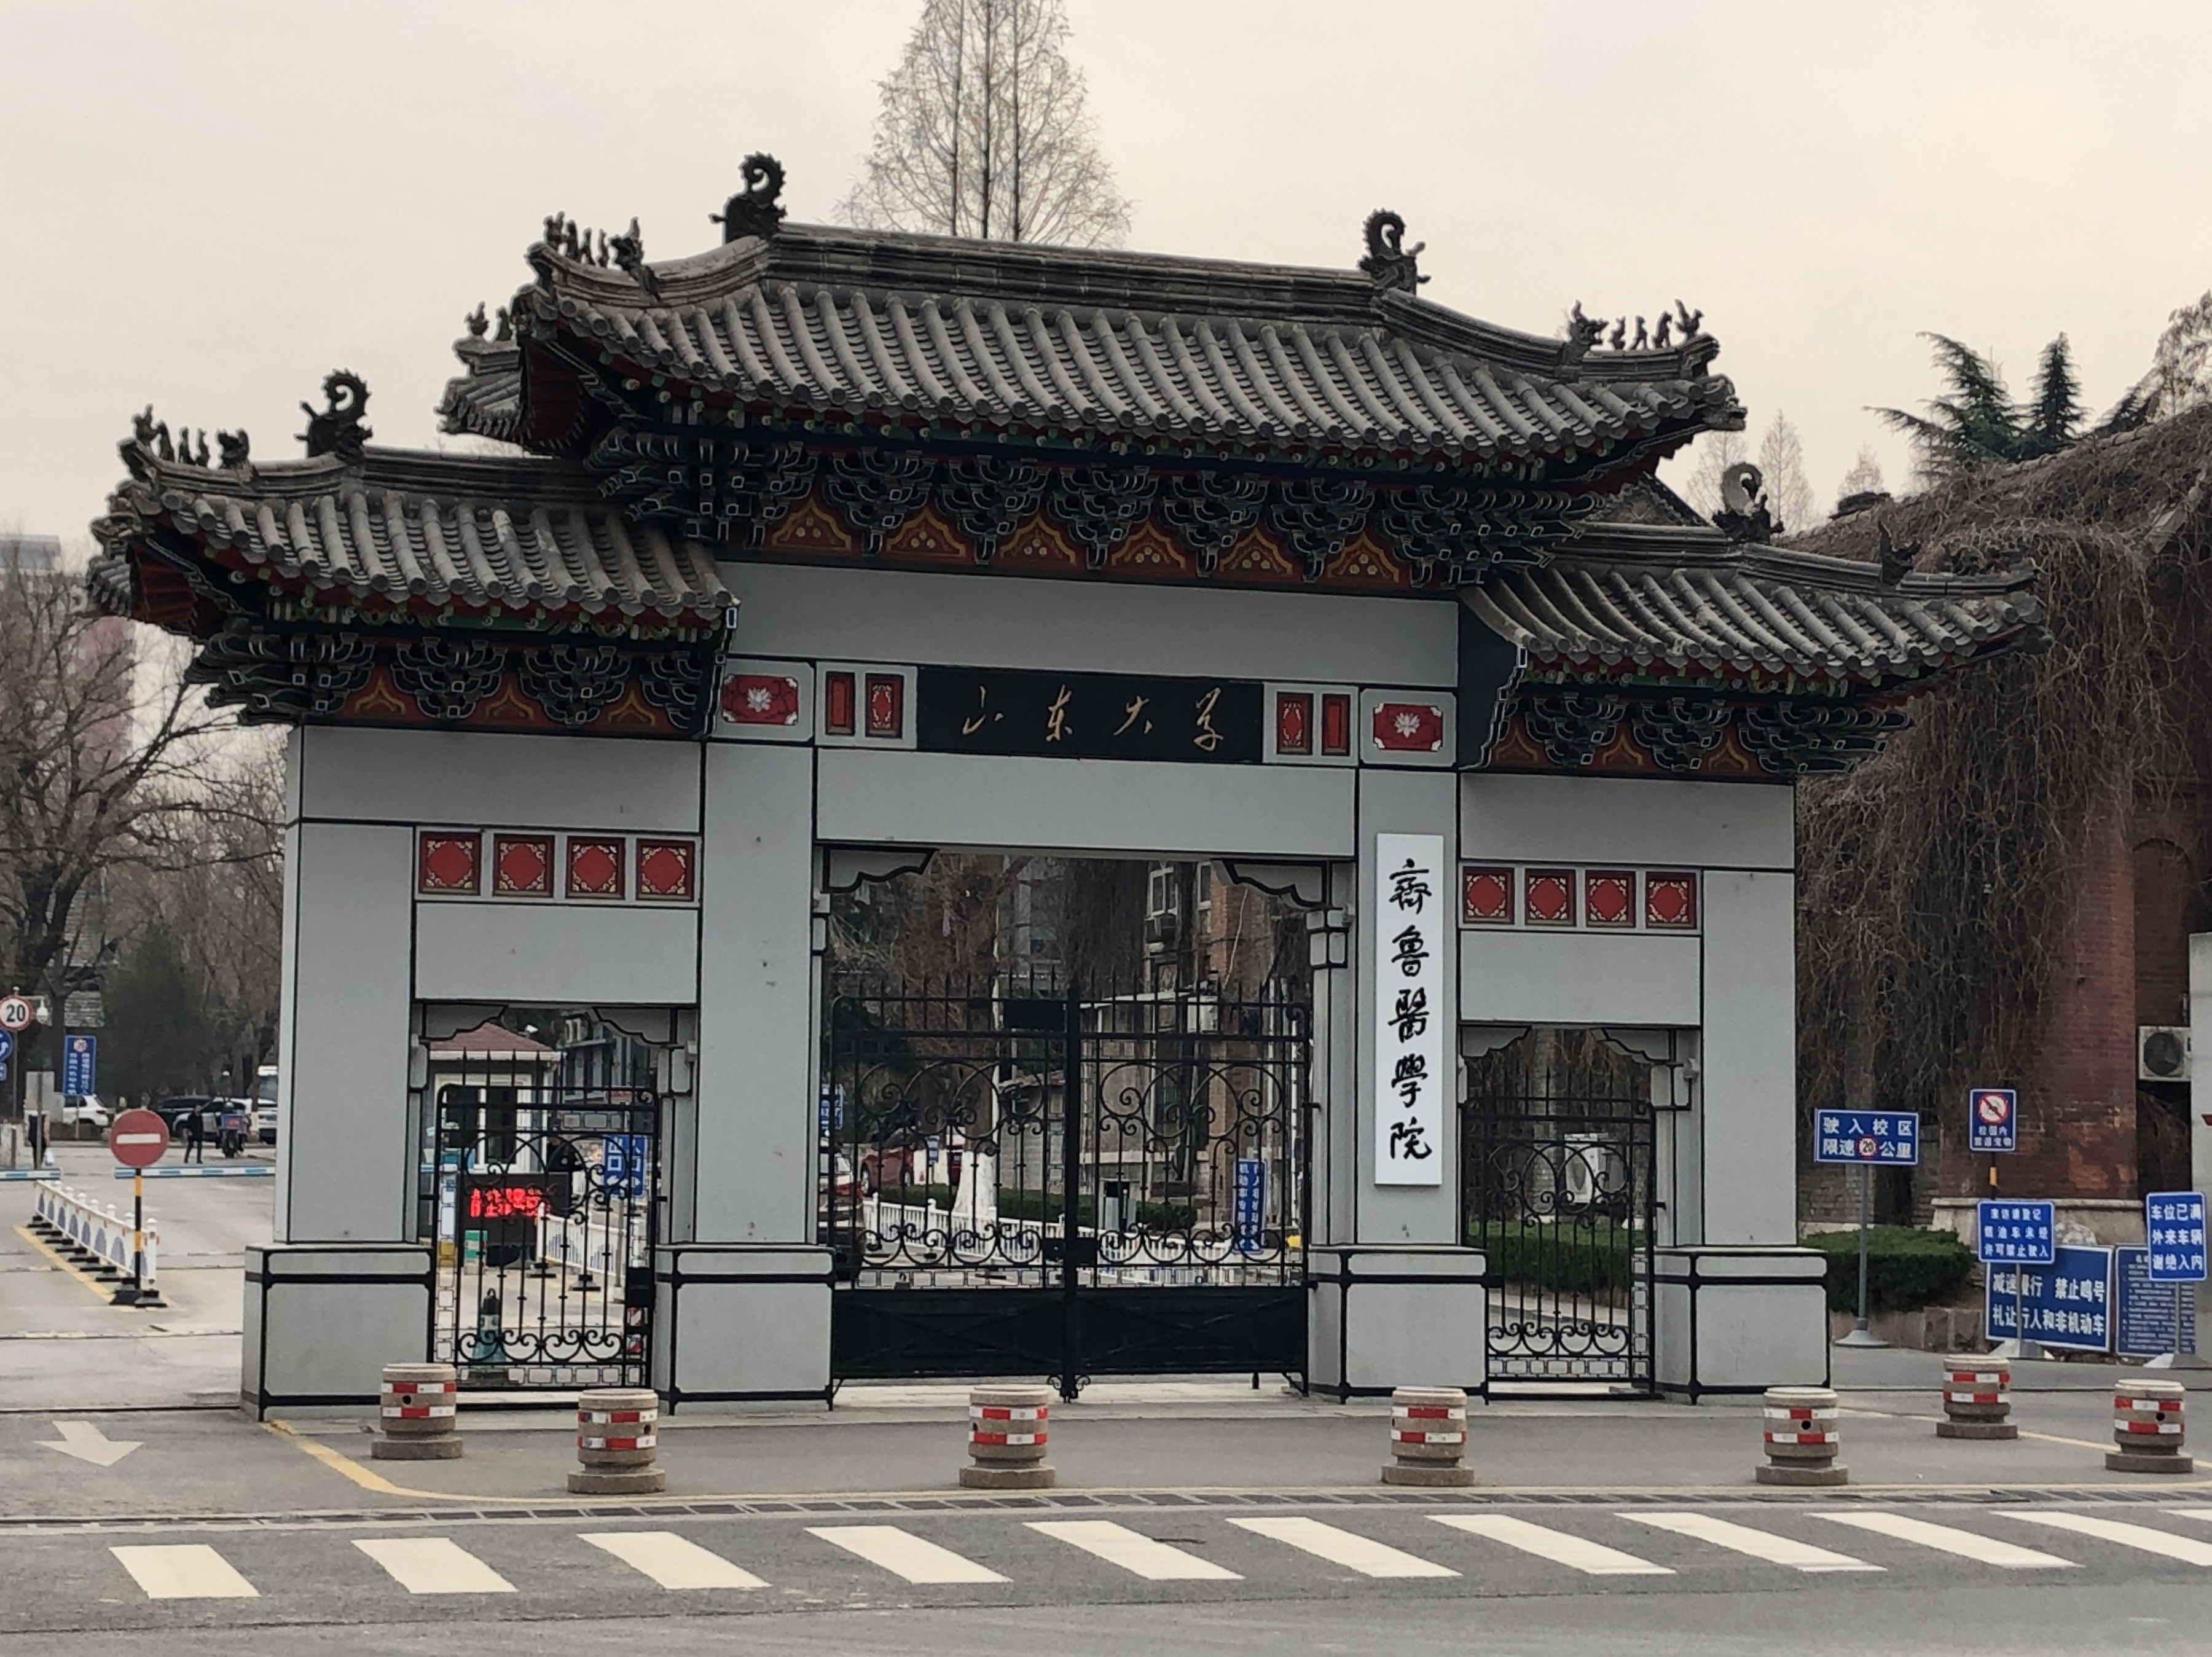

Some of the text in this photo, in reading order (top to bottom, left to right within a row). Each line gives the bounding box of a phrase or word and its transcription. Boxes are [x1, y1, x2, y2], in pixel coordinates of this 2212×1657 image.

[6, 1004, 26, 1023] 20
[1822, 1117, 1912, 1135] 驶入校区
[2151, 1203, 2202, 1221] 车位已满
[2152, 1228, 2202, 1245] 外来车辆
[2152, 1253, 2203, 1271] 谢绝入内
